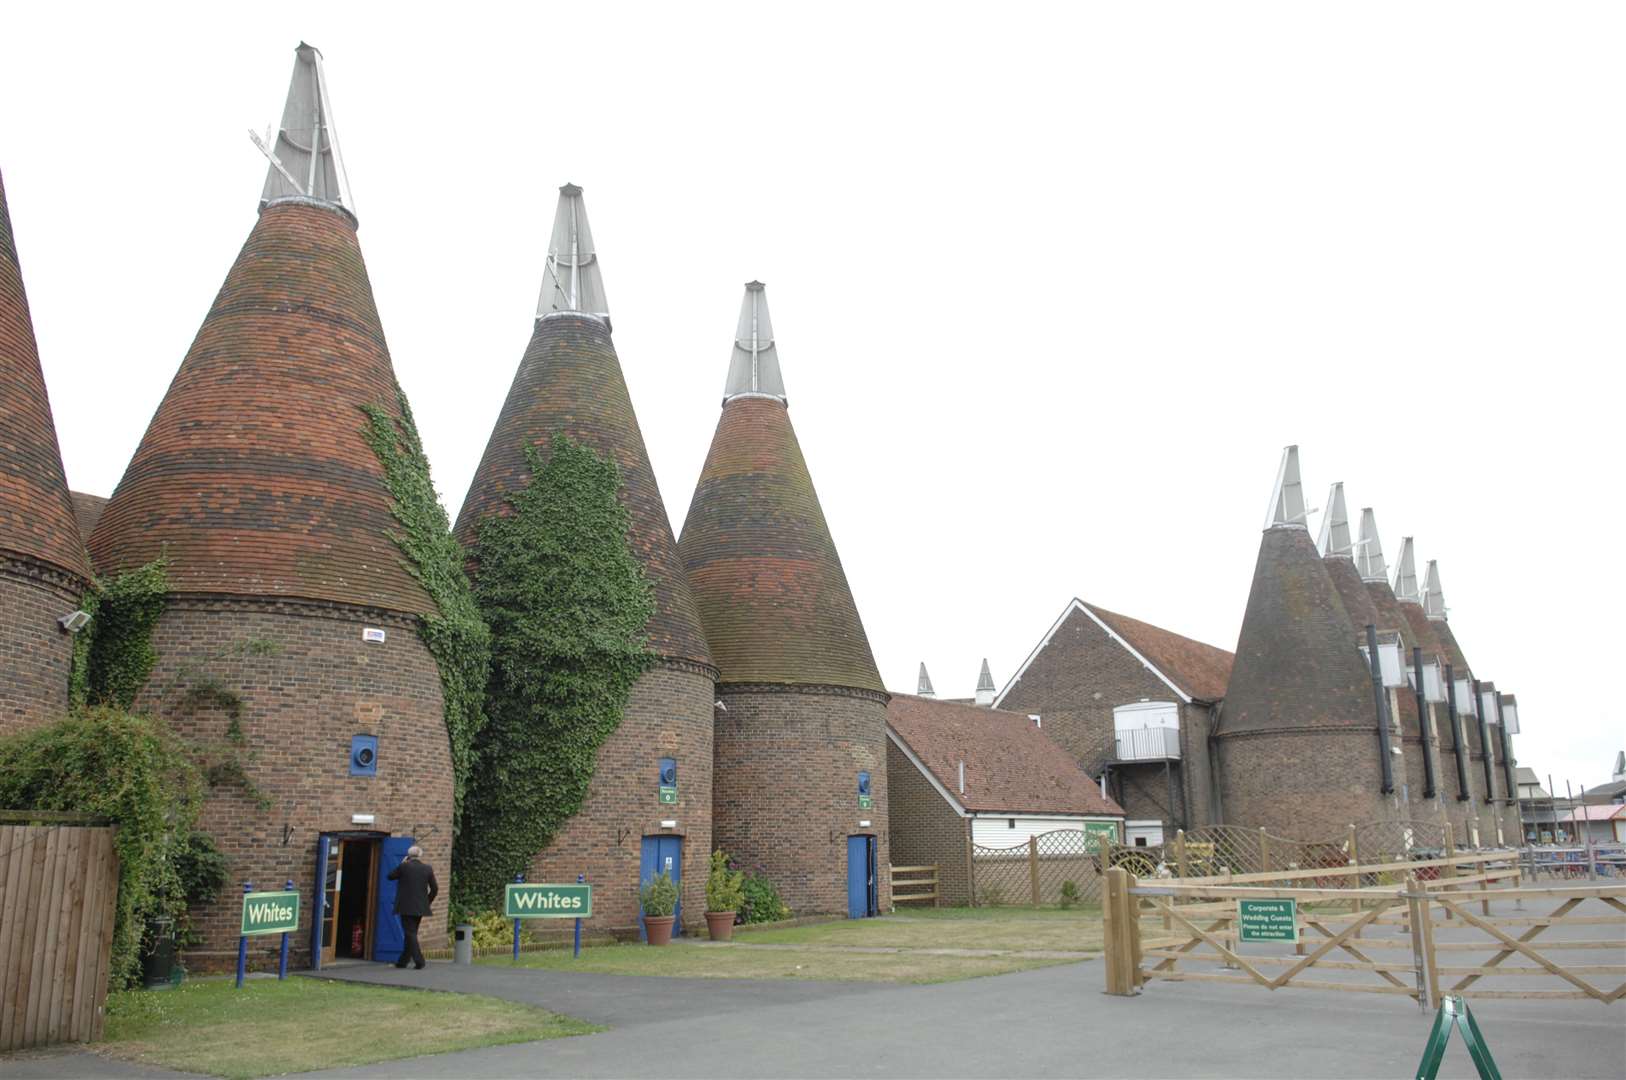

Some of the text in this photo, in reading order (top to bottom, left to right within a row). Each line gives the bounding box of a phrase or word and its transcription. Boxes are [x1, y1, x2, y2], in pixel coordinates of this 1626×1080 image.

[514, 892, 582, 909] Whites
[249, 902, 293, 924] Whites
[1243, 914, 1268, 922] Wedding
